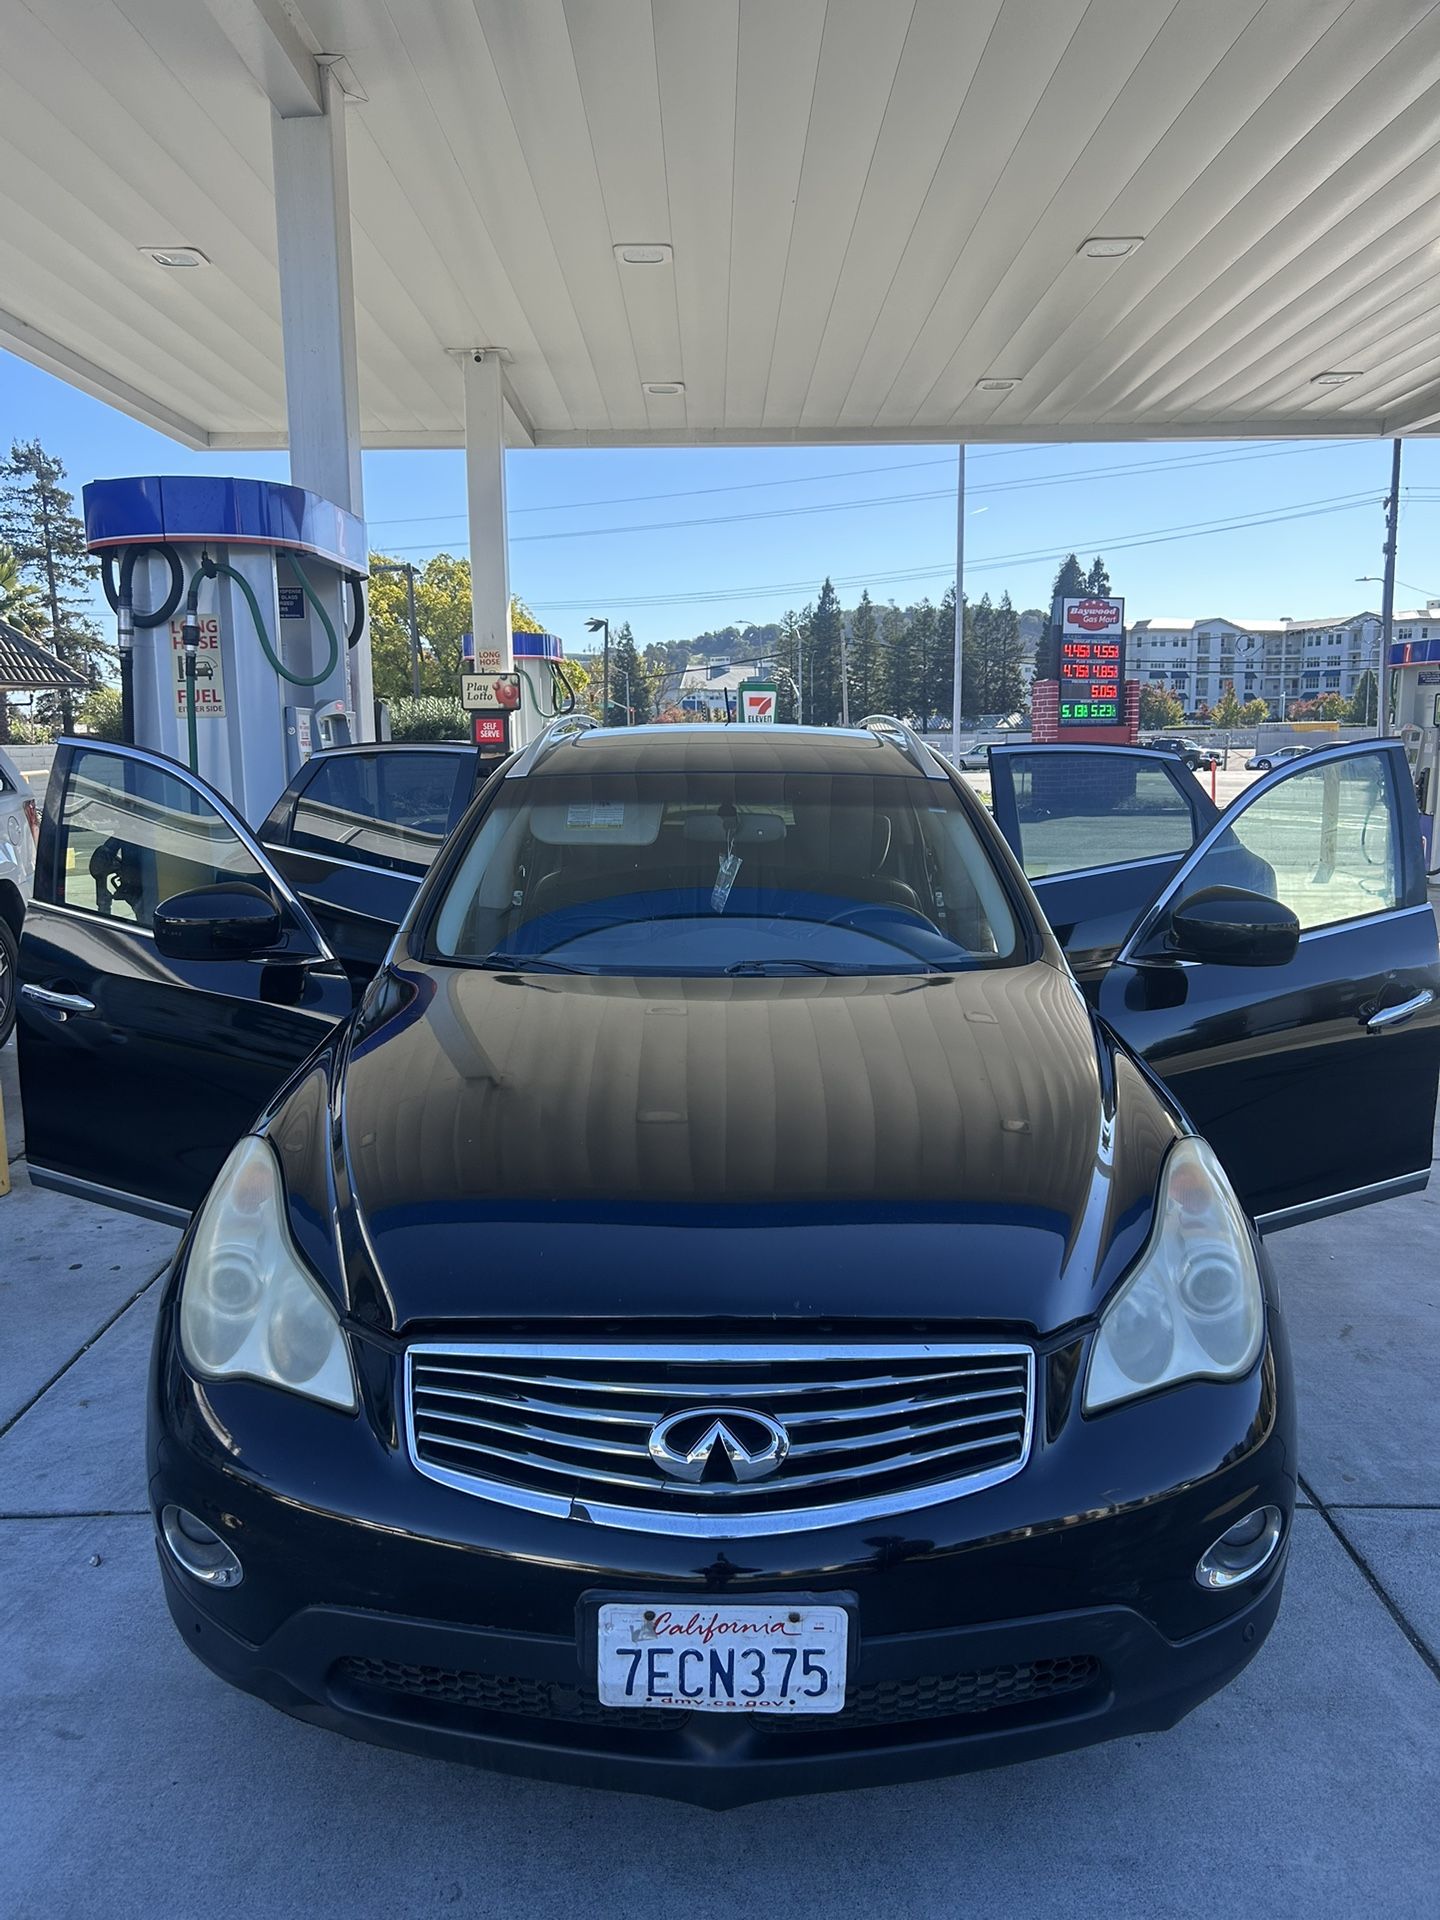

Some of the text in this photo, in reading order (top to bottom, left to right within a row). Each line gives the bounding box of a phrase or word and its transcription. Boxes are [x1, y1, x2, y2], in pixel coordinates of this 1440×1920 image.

[1070, 607, 1117, 616] Baywood
[1083, 615, 1117, 623] Gas Mart
[173, 635, 219, 650] HSE
[479, 651, 500, 659] LONG
[466, 682, 489, 692] Play
[467, 692, 493, 701] Lotto
[178, 705, 224, 713] EIER SIDE
[749, 697, 772, 715] 7
[482, 722, 497, 730] SELF
[480, 730, 500, 738] SERVE
[653, 1612, 801, 1644] California
[616, 1648, 828, 1698] 7ECN375
[661, 1697, 784, 1707] dmv.ca.gov
